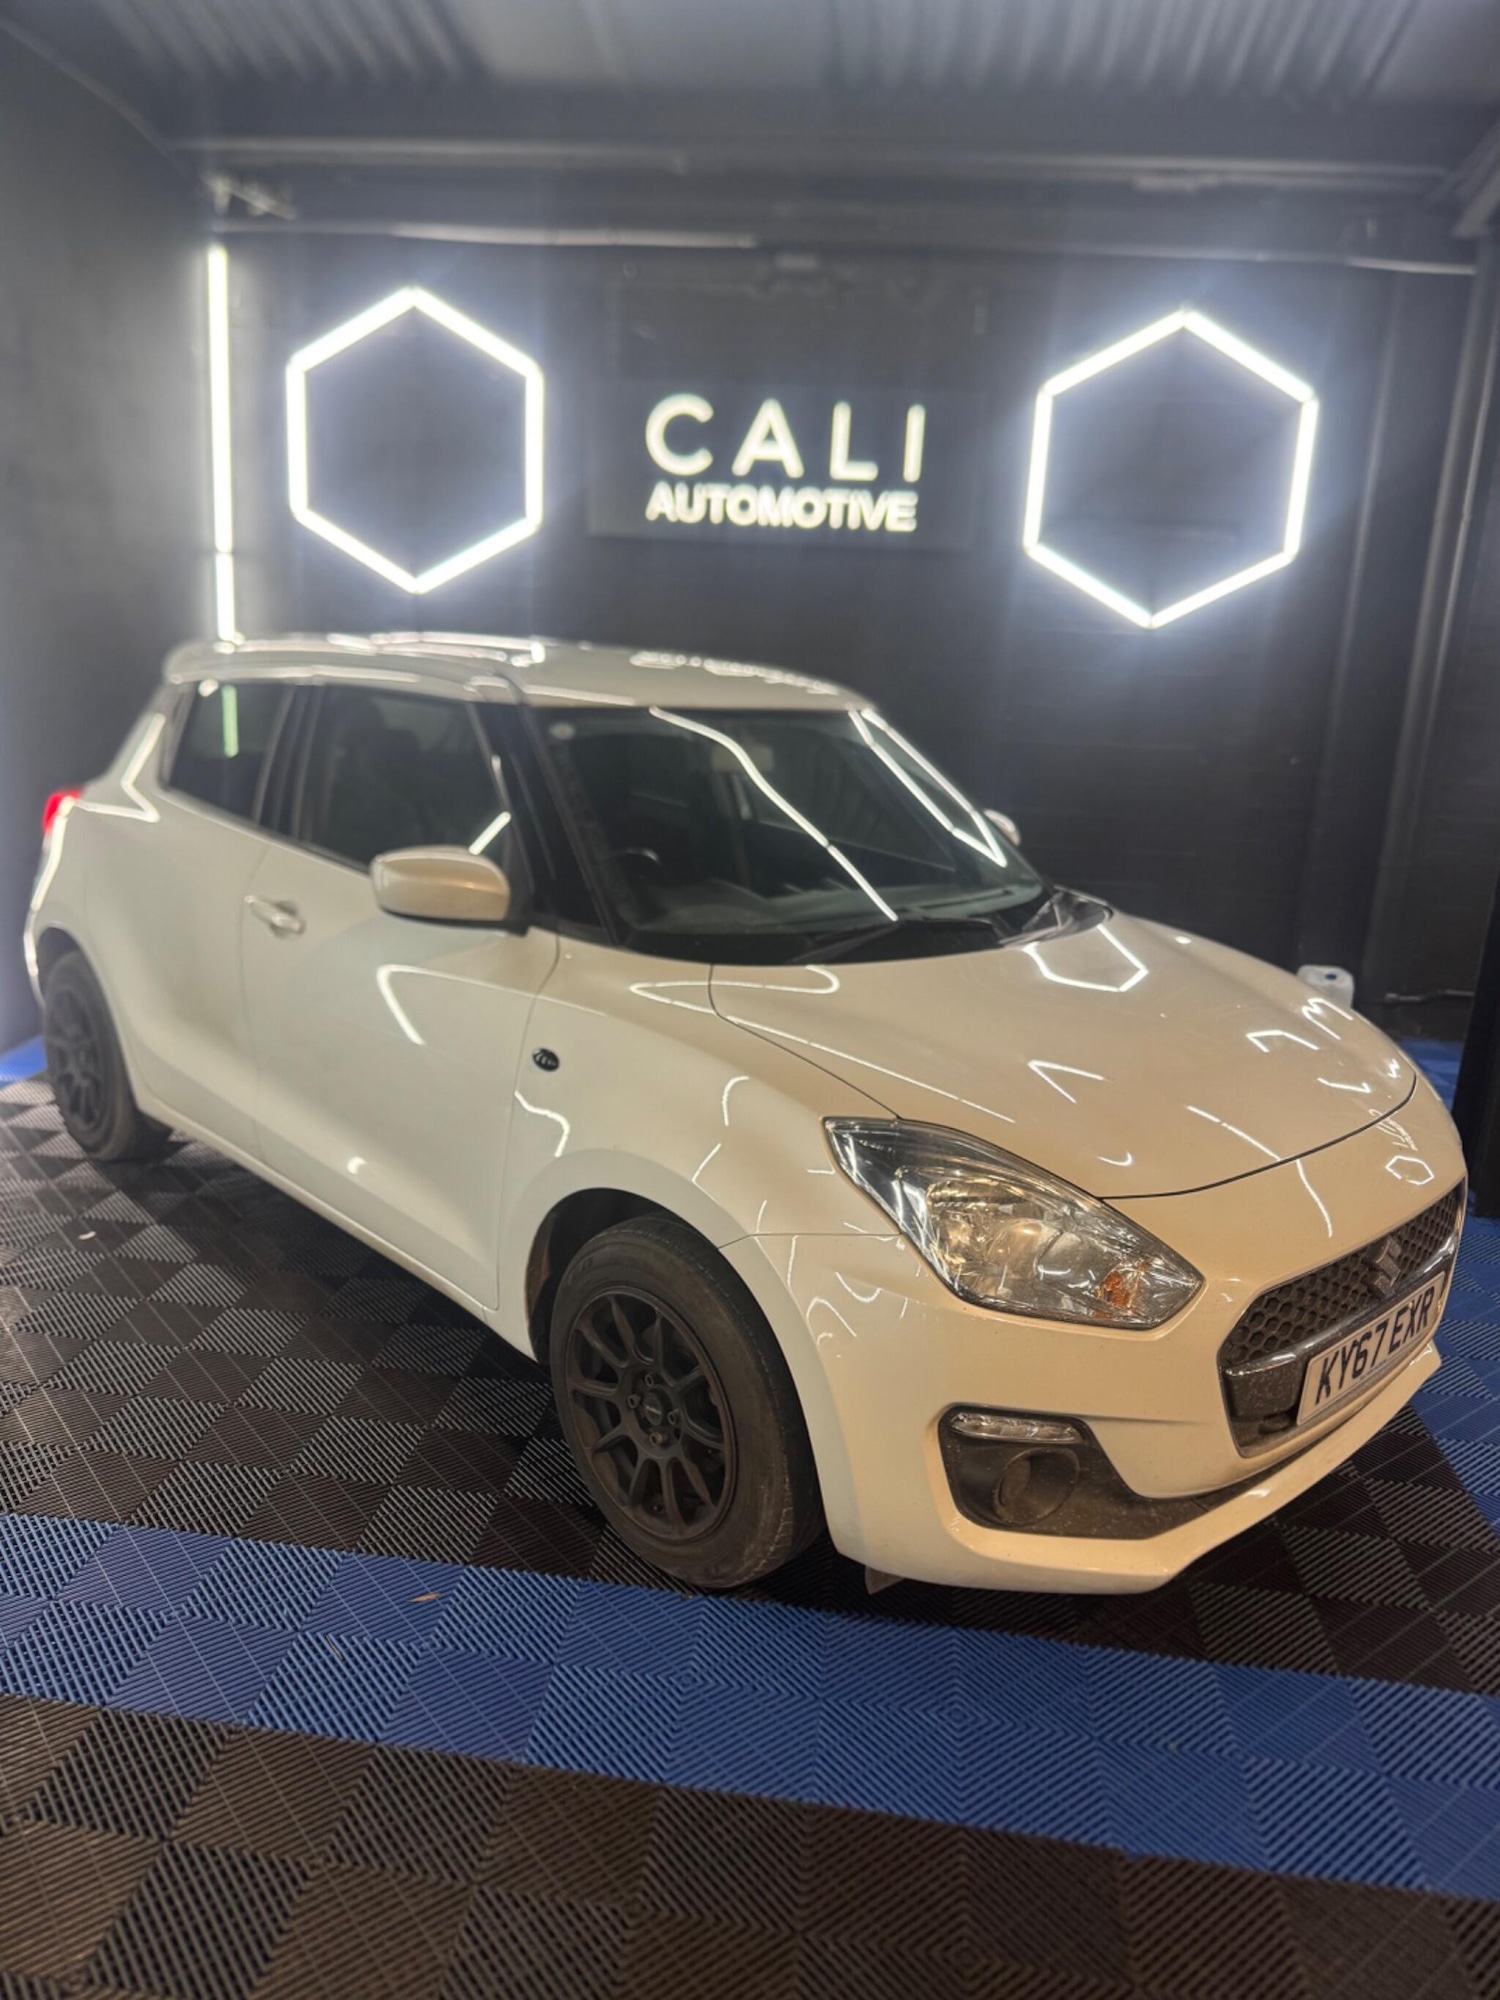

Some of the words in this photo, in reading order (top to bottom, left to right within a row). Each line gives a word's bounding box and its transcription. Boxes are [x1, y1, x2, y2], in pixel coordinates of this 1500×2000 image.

[645, 393, 926, 483] CALI
[645, 481, 919, 532] AUTOMOTIVE
[1314, 1318, 1390, 1405] KY67
[1388, 1286, 1435, 1355] EXR
